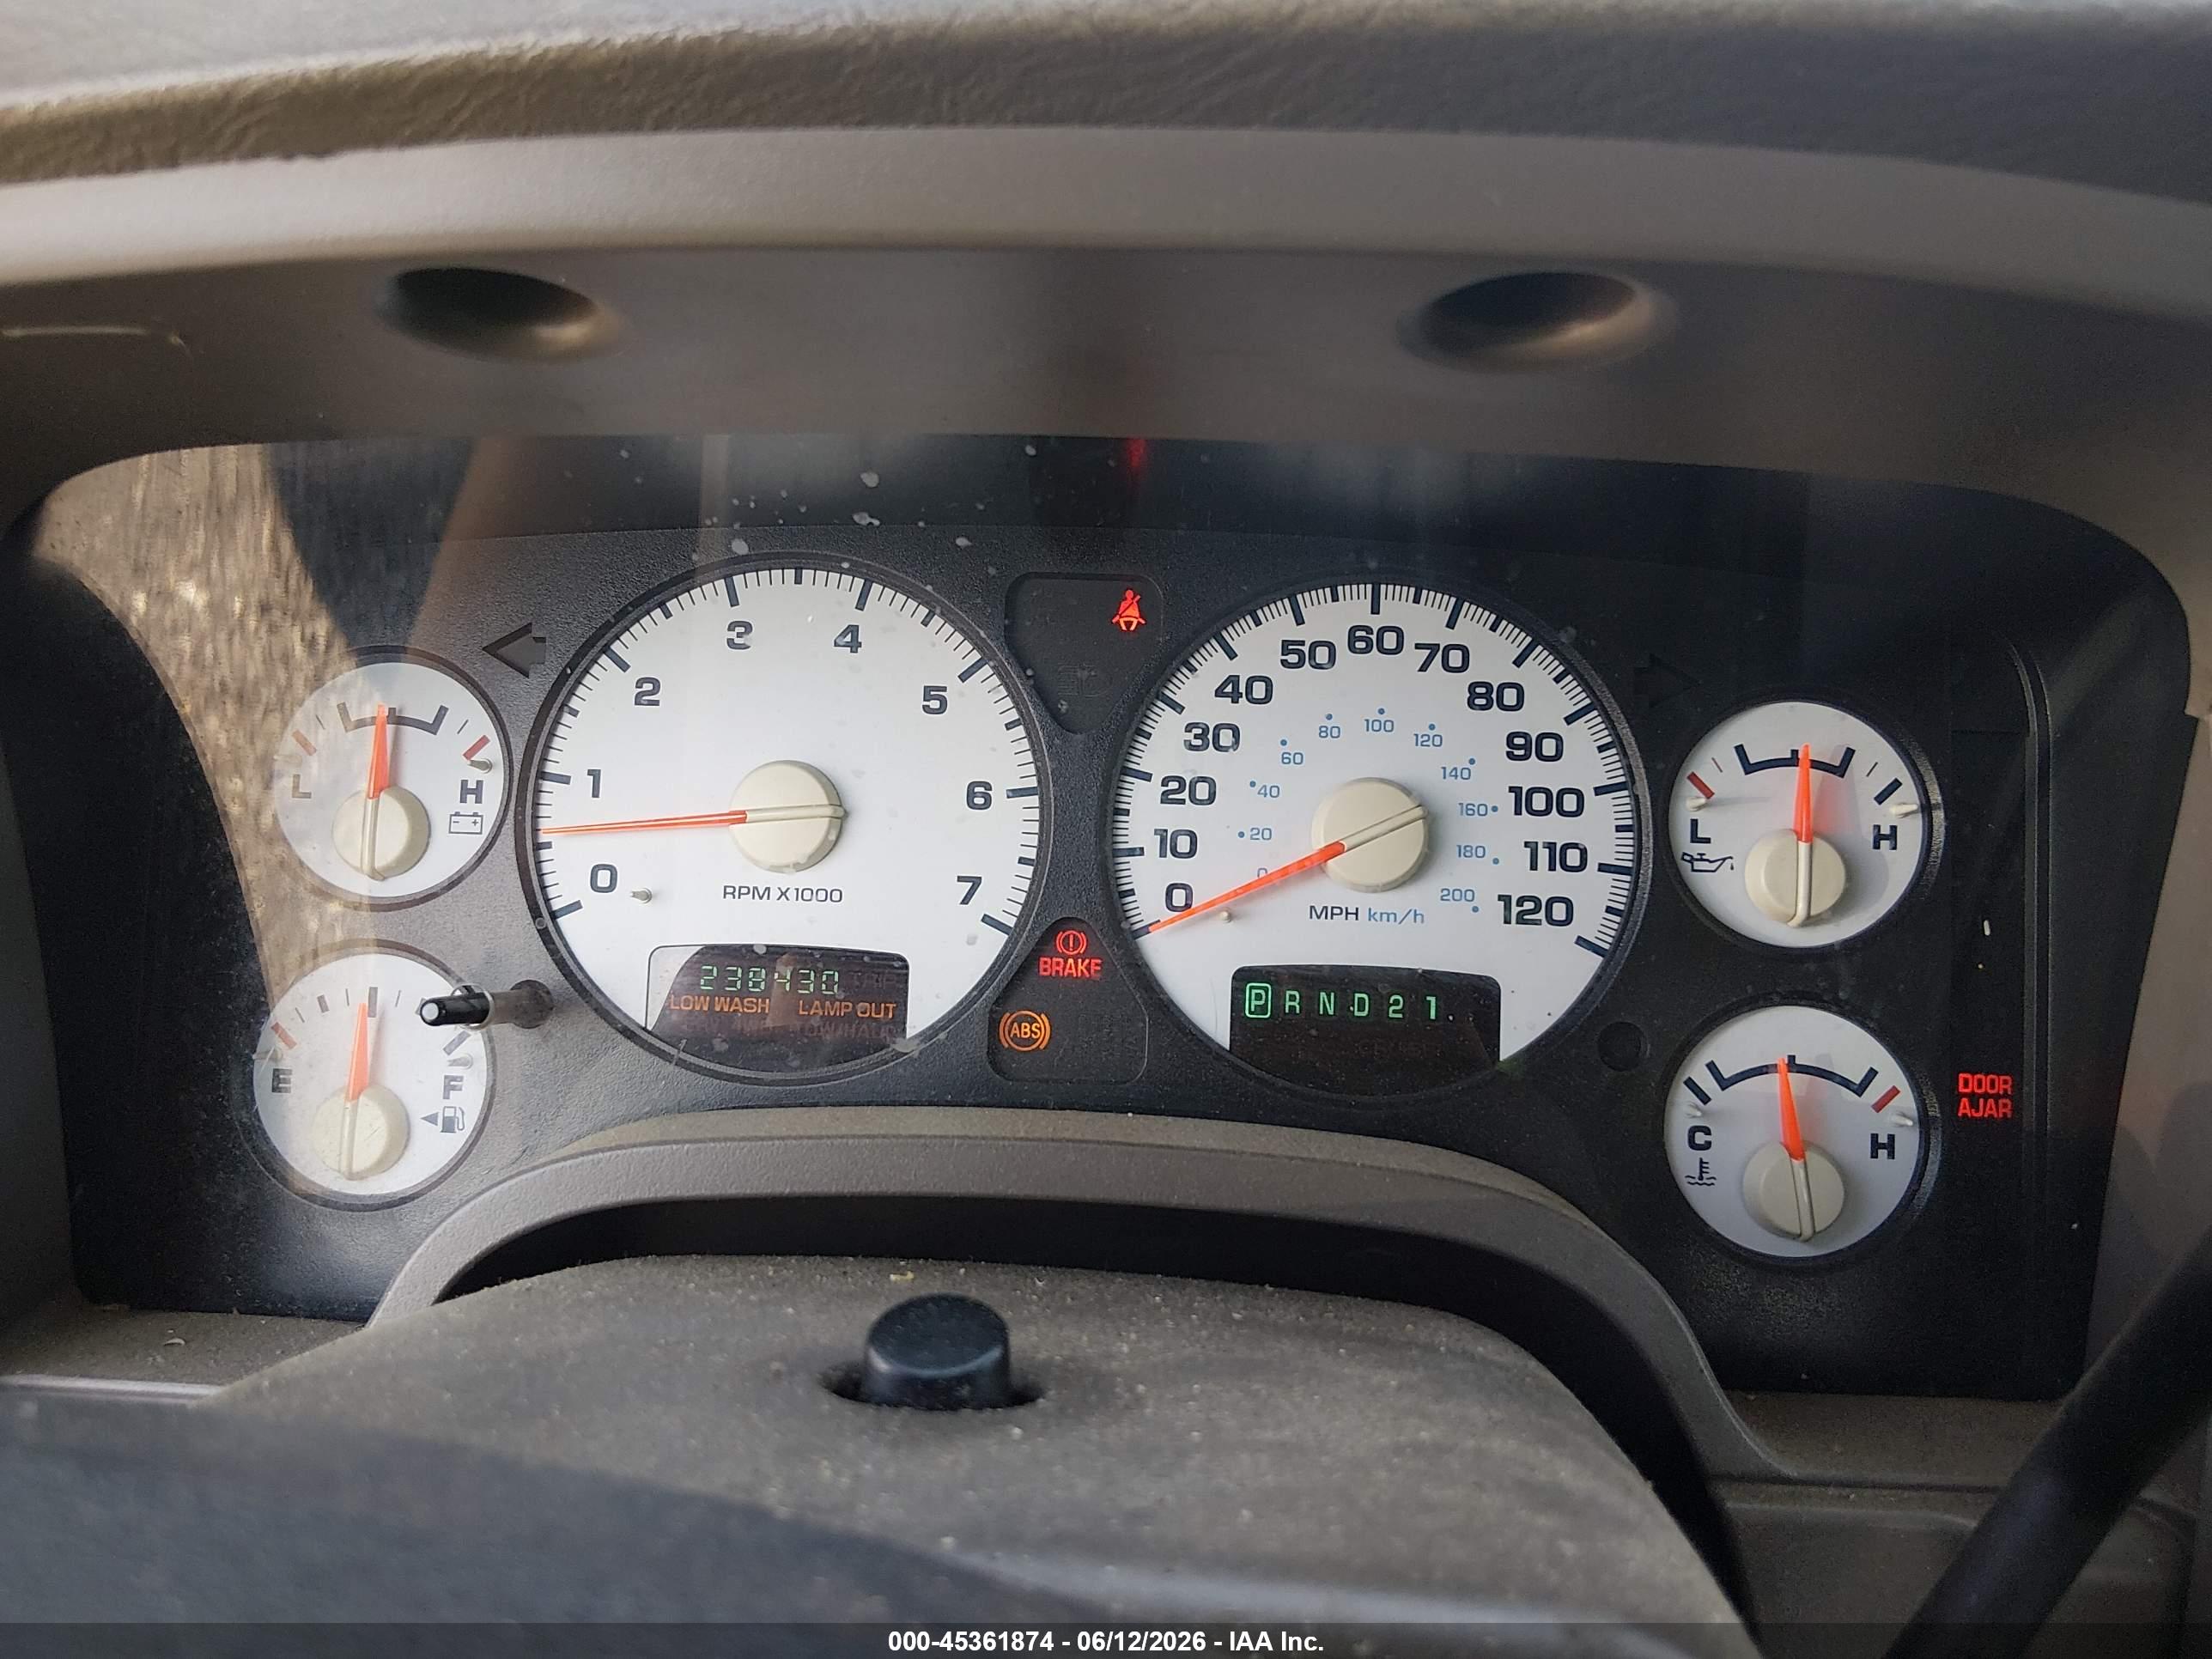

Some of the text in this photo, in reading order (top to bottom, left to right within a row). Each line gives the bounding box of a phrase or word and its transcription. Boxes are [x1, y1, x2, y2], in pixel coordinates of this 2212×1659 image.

[726, 621, 752, 649] 3
[834, 625, 861, 653] 4
[1348, 625, 1404, 655] 60
[1280, 640, 1336, 670] 50
[1415, 643, 1469, 673] 70
[635, 678, 660, 706] 2
[922, 686, 947, 714] 5
[1215, 675, 1273, 704] 40
[1468, 682, 1524, 711] 80
[1184, 722, 1240, 752] 30
[1319, 726, 1340, 738] 80
[1364, 720, 1394, 732] 100
[1414, 734, 1443, 747] 120
[1506, 732, 1563, 762] 90
[1281, 751, 1304, 765] 60
[587, 769, 600, 798] 1
[1442, 767, 1471, 780] 140
[292, 775, 312, 799] L
[460, 780, 483, 804] H
[967, 781, 992, 810] 6
[1160, 775, 1216, 805] 20
[1258, 785, 1279, 798] 40
[1459, 803, 1487, 816] 160
[1509, 787, 1584, 817] 100
[1154, 829, 1197, 859] 10
[1250, 828, 1272, 840] 20
[1690, 819, 1711, 843] L
[1873, 824, 1897, 850] H
[1456, 845, 1486, 858] 180
[1524, 842, 1587, 872] 110
[590, 864, 617, 893] 0
[957, 876, 982, 905] 7
[723, 885, 771, 901] RPM
[1164, 883, 1194, 912] 0
[1440, 888, 1476, 902] 200
[1309, 906, 1424, 924] MPH km/h
[1498, 895, 1573, 927] 120
[700, 965, 839, 995] 238430
[1039, 957, 1102, 979] BRAKE
[668, 994, 769, 1012] LOW WASH
[799, 1000, 896, 1018] LAMP OUT
[1250, 989, 1437, 1019] P R N D 2 1
[1010, 1022, 1041, 1039] ABS
[271, 1068, 292, 1094] E
[443, 1075, 463, 1099] F
[1958, 1073, 2011, 1094] DOOR
[1959, 1097, 2010, 1117] AJAR
[1688, 1126, 1711, 1151] C
[1870, 1133, 1895, 1159] H
